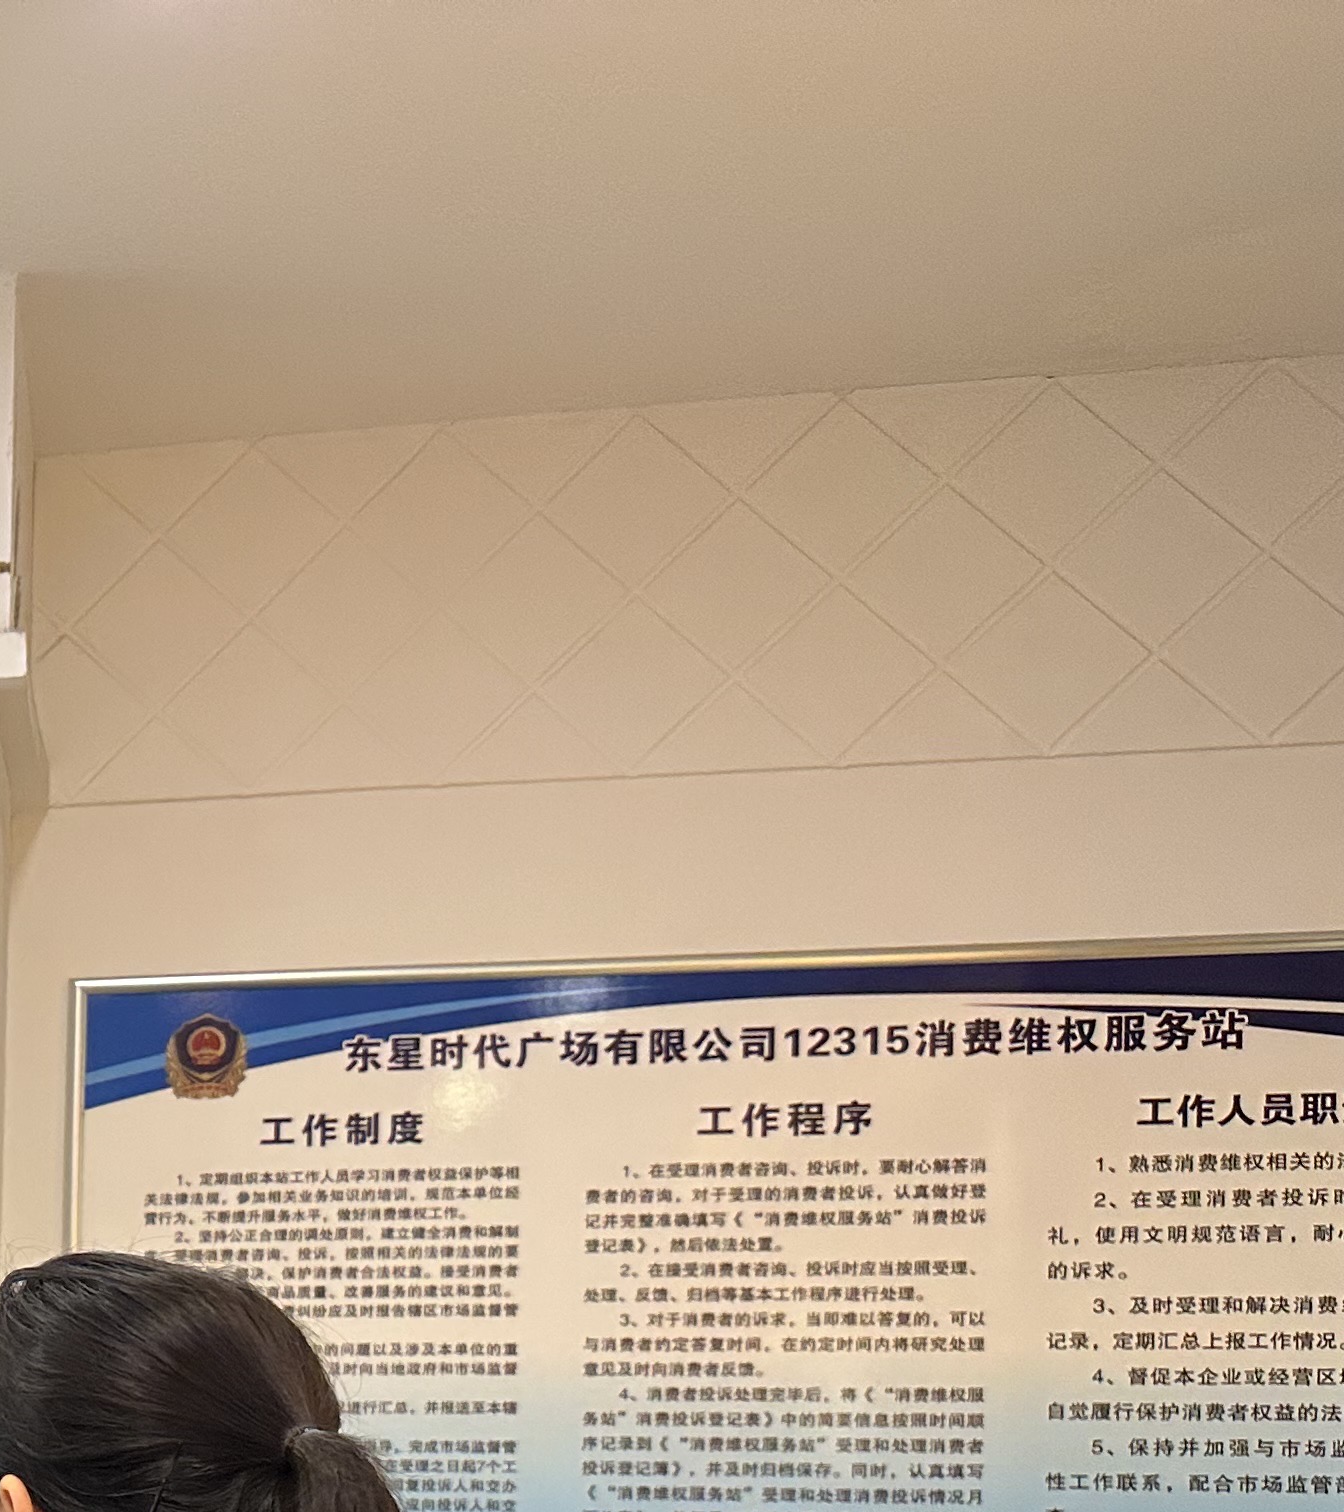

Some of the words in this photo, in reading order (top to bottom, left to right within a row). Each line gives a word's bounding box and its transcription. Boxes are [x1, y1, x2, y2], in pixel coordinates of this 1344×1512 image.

[343, 1010, 1247, 1073] 东星时代广场有限公司12315消费维权服务站
[696, 1100, 873, 1137] 工作程序
[1136, 1092, 1344, 1128] 工作人员职
[259, 1111, 425, 1147] 工作制度
[1047, 1261, 1127, 1281] 的诉求。
[1092, 1295, 1344, 1315] 3、及时受理和解决消费
